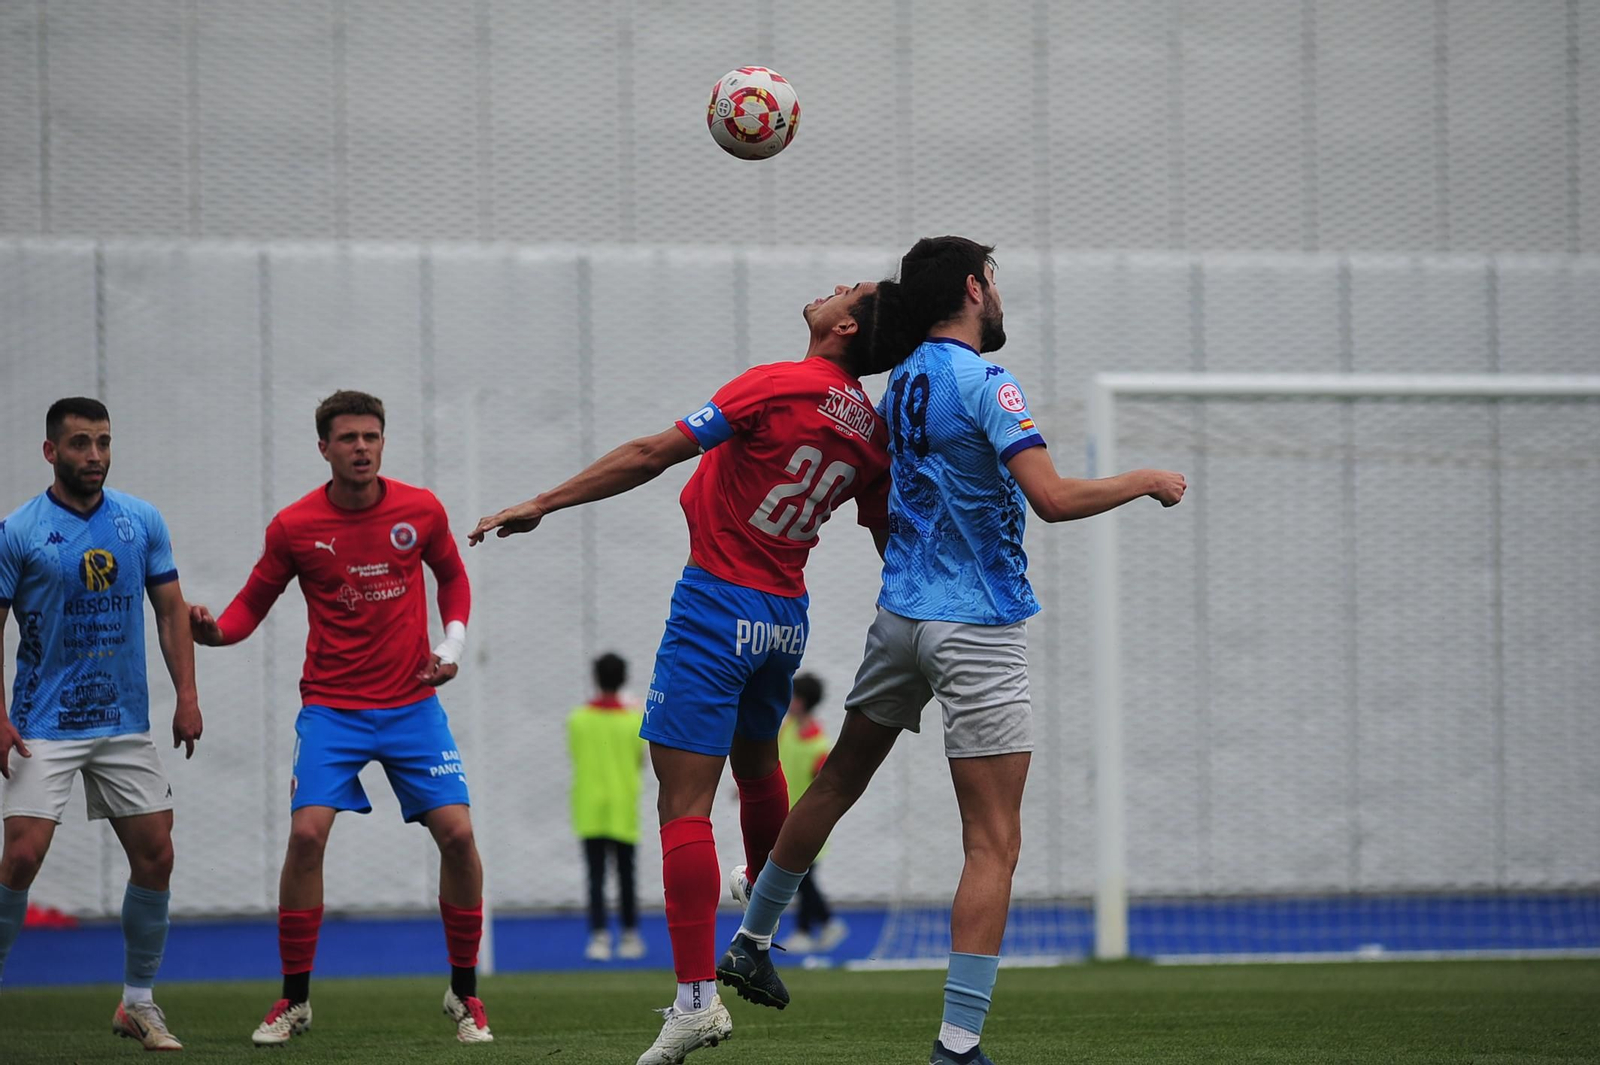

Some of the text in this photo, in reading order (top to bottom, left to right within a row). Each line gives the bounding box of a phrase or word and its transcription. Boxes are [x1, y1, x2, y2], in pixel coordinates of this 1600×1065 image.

[688, 406, 715, 428] C
[891, 371, 931, 457] 19
[748, 445, 856, 541] 20
[63, 595, 134, 616] RESORT
